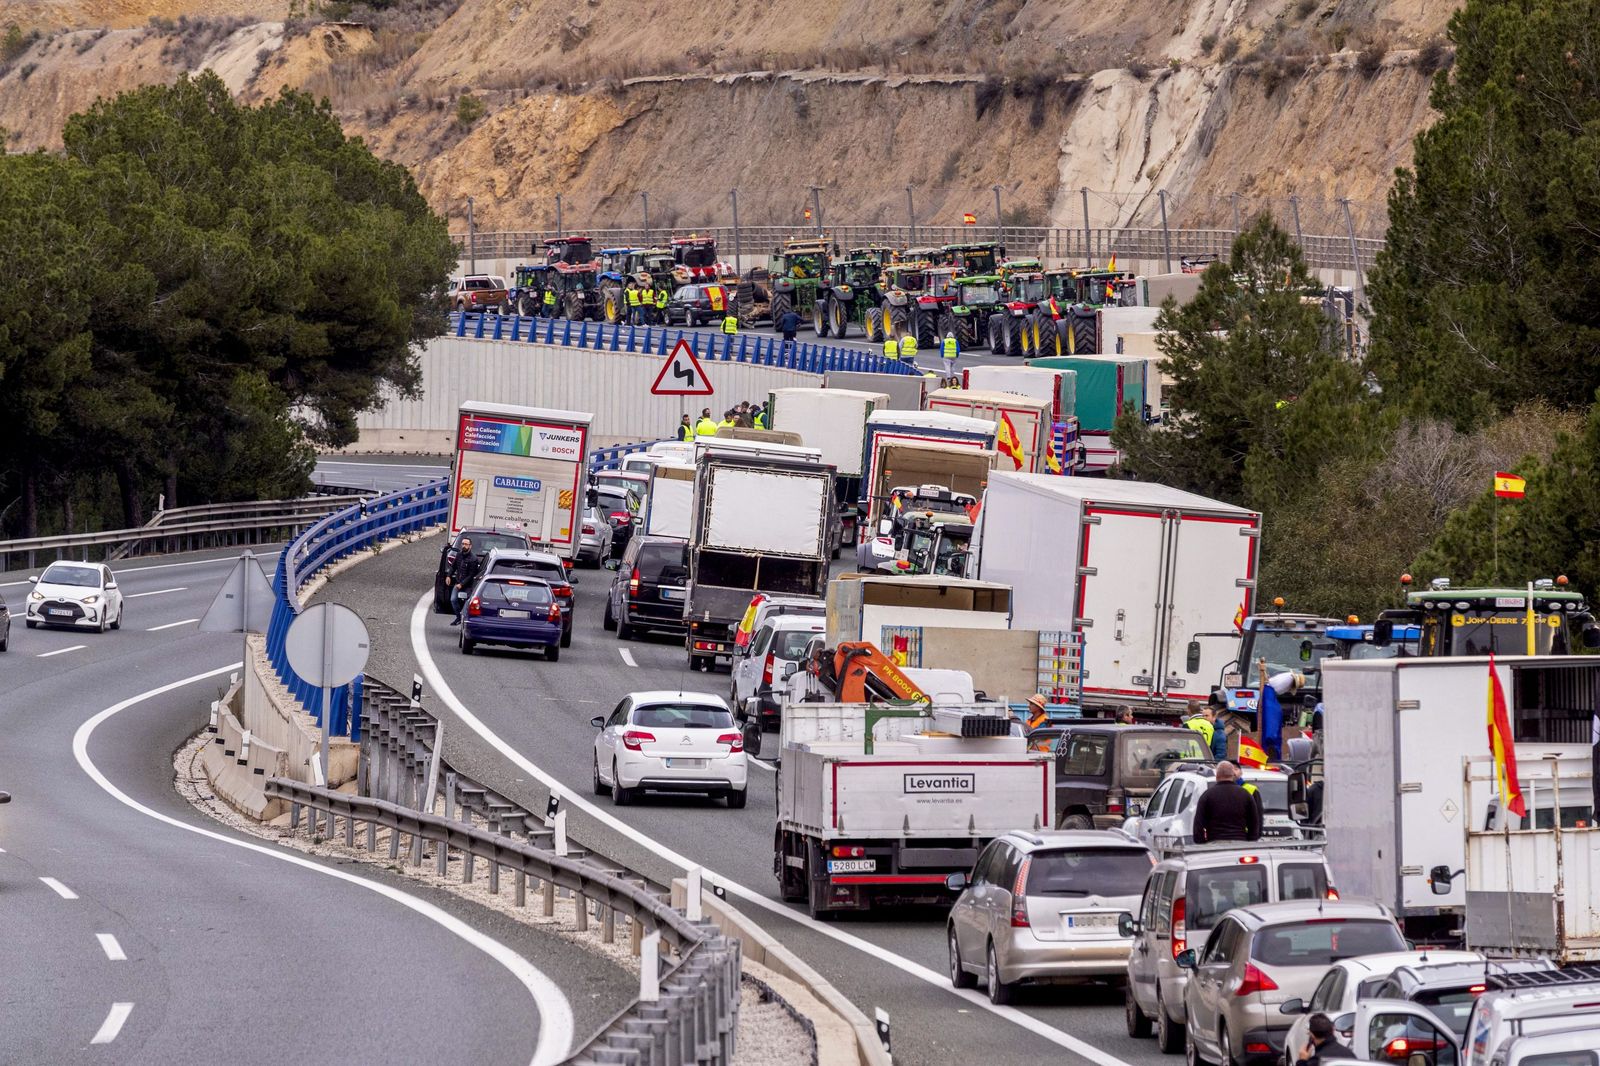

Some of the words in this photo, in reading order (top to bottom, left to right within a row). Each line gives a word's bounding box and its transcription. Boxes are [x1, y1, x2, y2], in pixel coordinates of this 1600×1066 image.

[465, 425, 479, 433] Agua
[465, 432, 495, 440] Calefacción
[546, 434, 580, 443] JUNKERS
[464, 438, 500, 447] Climatización
[552, 446, 575, 455] BOSCH
[495, 478, 540, 489] CABALLERO
[489, 514, 538, 524] www.caballero.eu
[1489, 616, 1518, 625] DEERE
[882, 665, 894, 677] PK
[892, 674, 912, 694] 8000
[910, 776, 969, 790] Levantia
[916, 797, 963, 805] www.levantia.es
[833, 861, 856, 870] 5280
[857, 861, 875, 870] LCM
